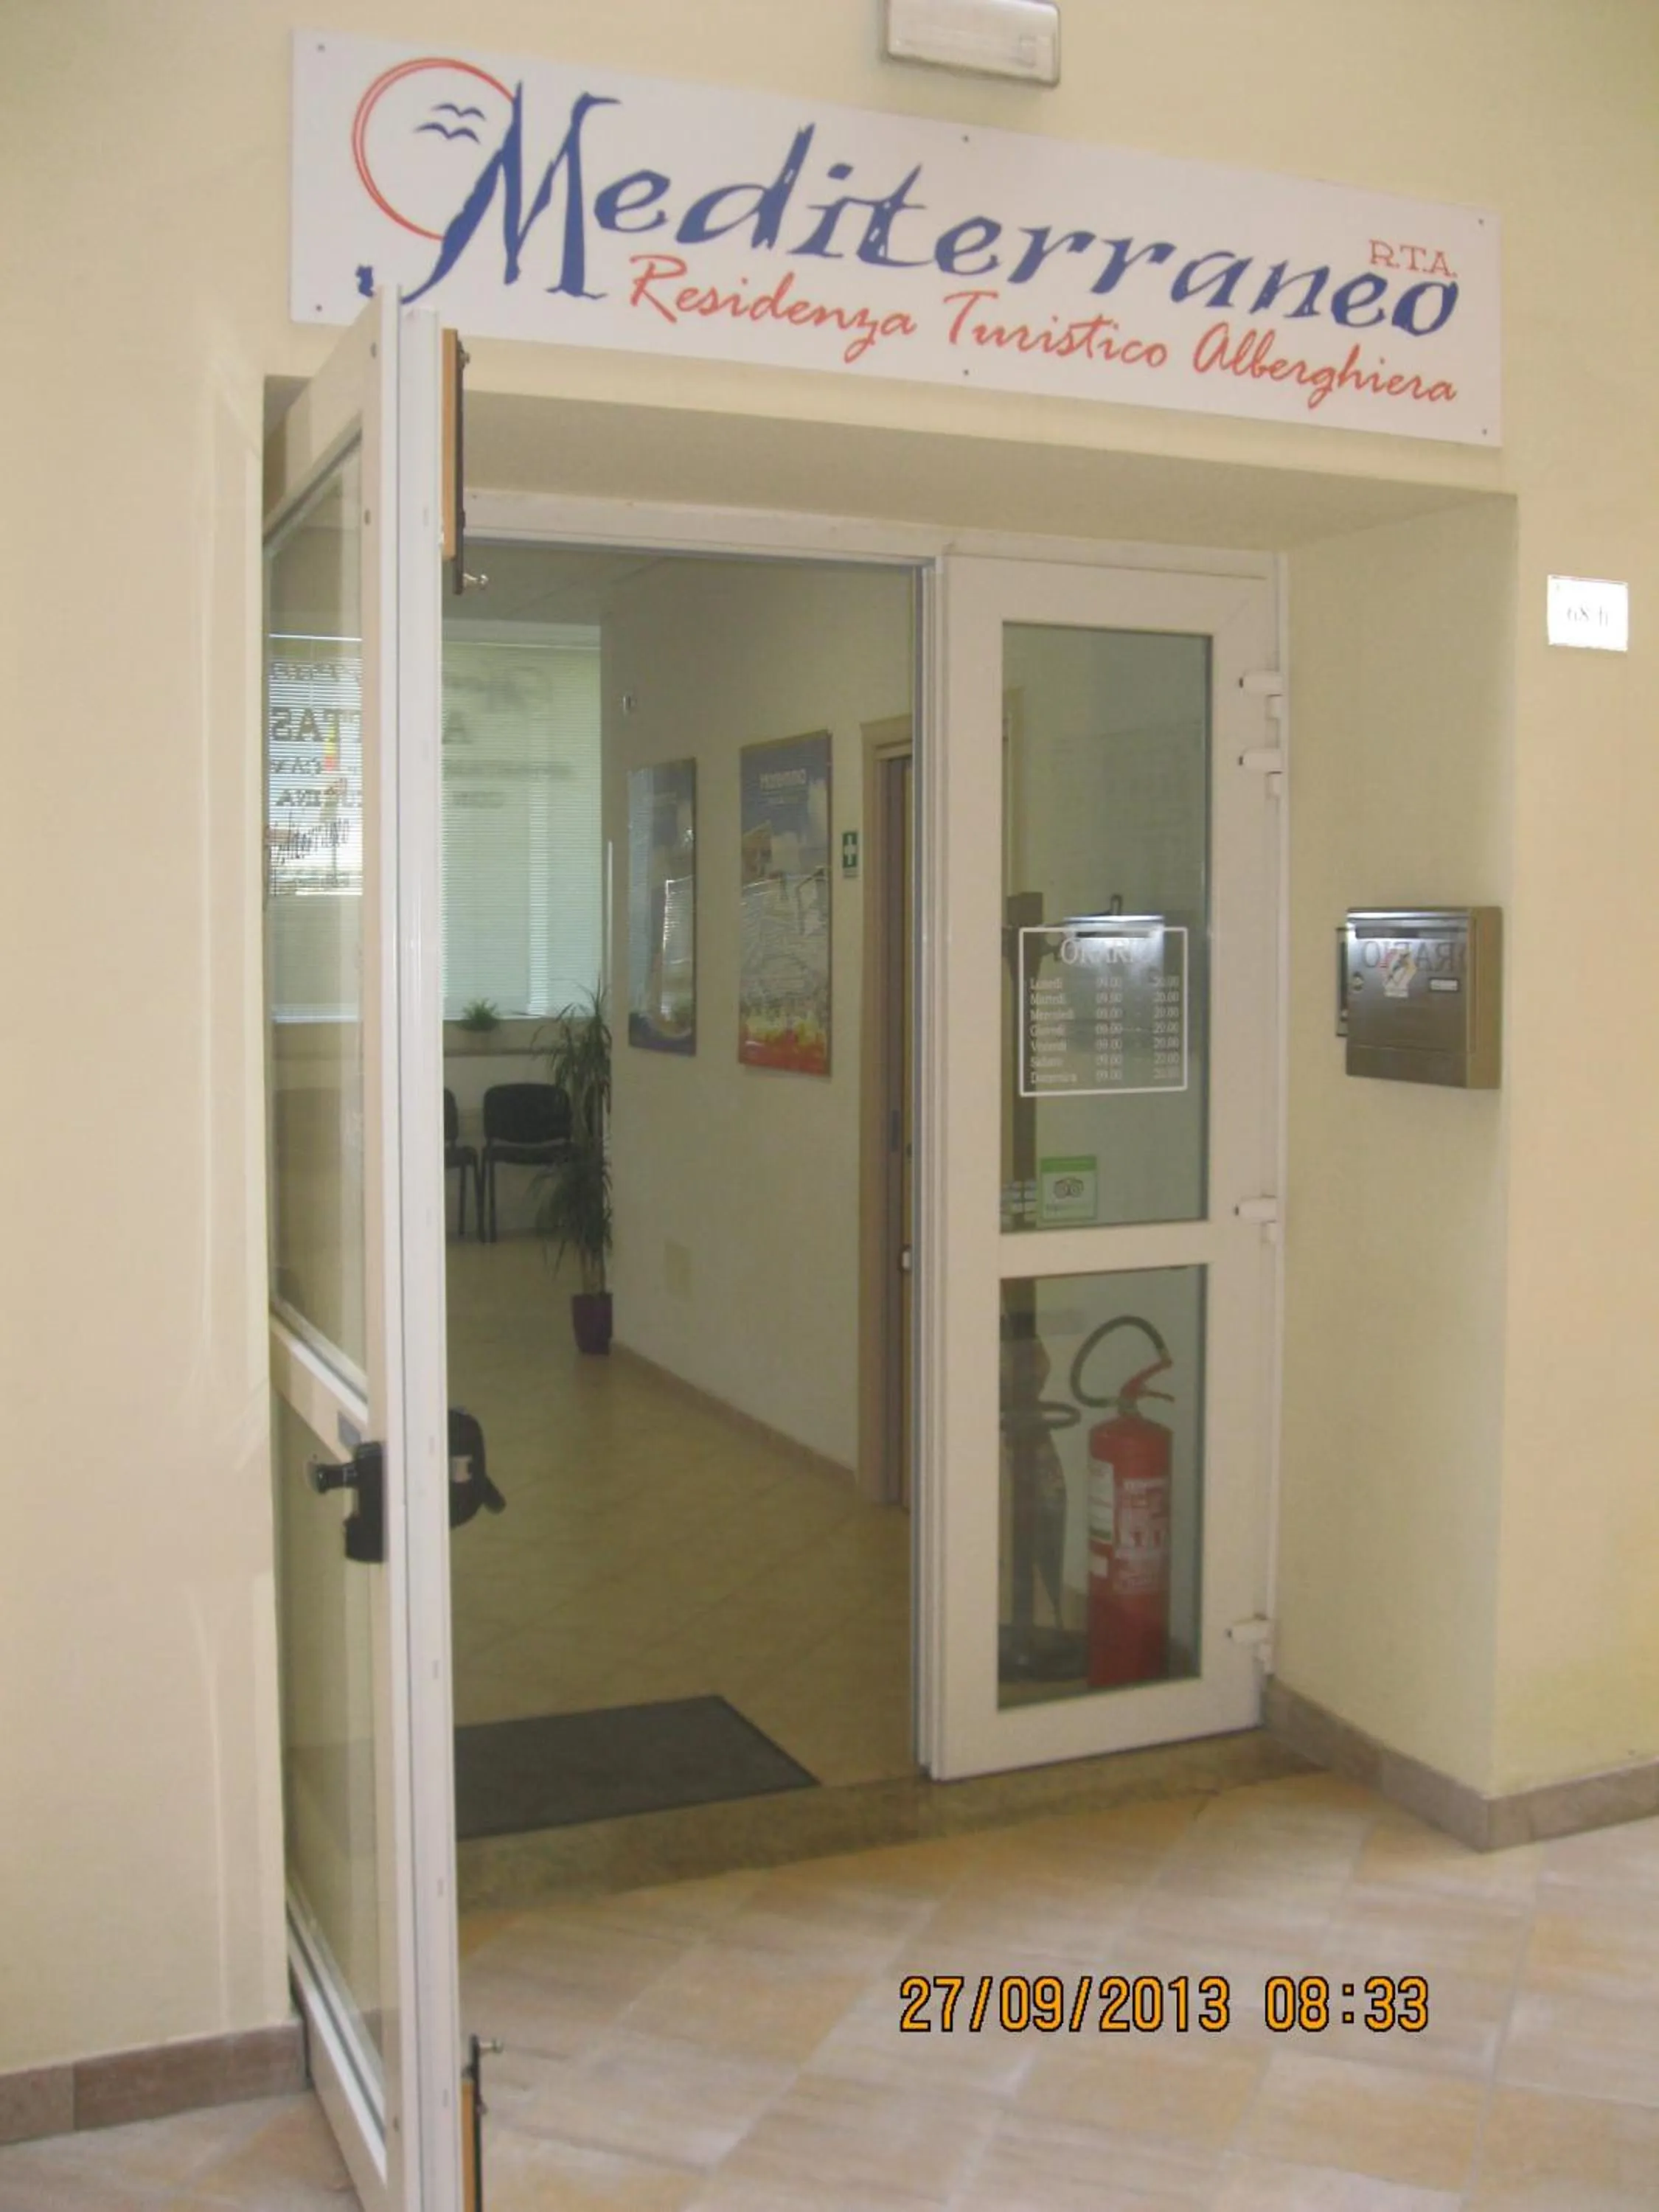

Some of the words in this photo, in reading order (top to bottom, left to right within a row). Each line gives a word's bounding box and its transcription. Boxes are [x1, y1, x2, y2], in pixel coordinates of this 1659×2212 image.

[355, 80, 1459, 337] Mediterraneo
[628, 253, 917, 363] Residenza
[942, 291, 1168, 369] Turistico
[1192, 321, 1457, 409] Alberghiera
